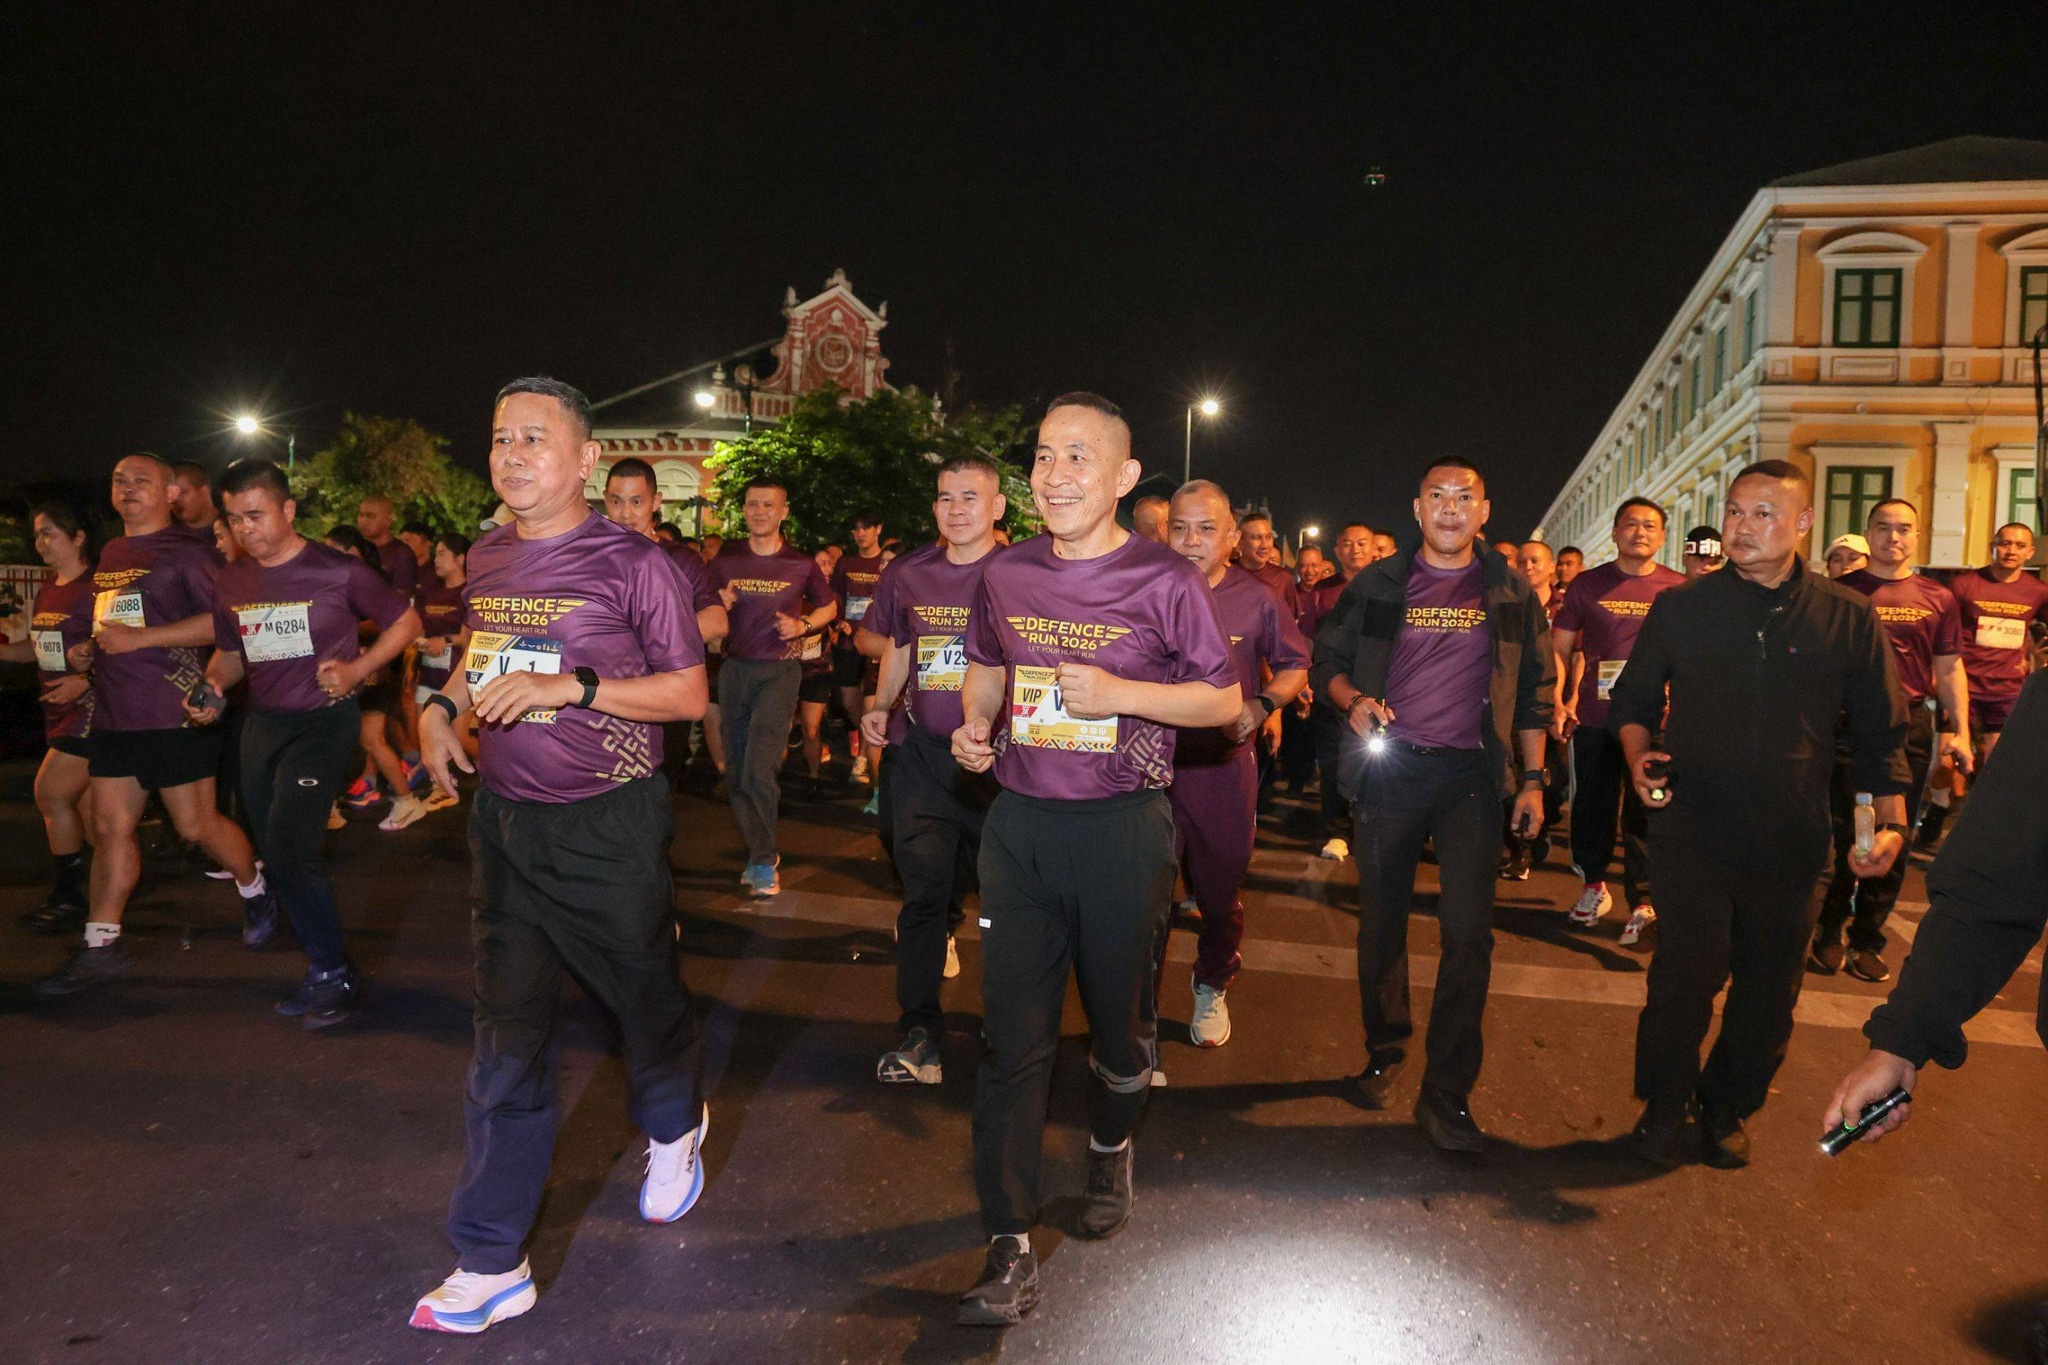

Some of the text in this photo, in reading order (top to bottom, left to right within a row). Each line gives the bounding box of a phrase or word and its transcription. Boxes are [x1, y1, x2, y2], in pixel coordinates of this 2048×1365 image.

[740, 579, 780, 589] DEFENCE
[115, 598, 140, 613] 6088
[482, 597, 557, 613] DEFENCE
[1611, 600, 1652, 610] DEFENC
[484, 611, 549, 626] RUN 2026
[1412, 607, 1477, 619] DEFENCE
[264, 618, 306, 636] M 6284
[929, 617, 968, 626] RUN 20
[1025, 616, 1106, 639] DEFENCE
[1414, 618, 1472, 628] RUN 2026
[246, 624, 257, 635] 3K
[495, 625, 512, 633] YOUR
[513, 626, 533, 634] HEART
[534, 627, 548, 635] RUN
[43, 641, 62, 654] 6078
[1028, 632, 1098, 651] RUN 2026
[922, 650, 935, 662] VIP
[1041, 646, 1060, 655] YOUR
[1061, 648, 1080, 657] HEART
[1081, 651, 1096, 660] RUN
[472, 653, 489, 669] VIP
[500, 655, 511, 675] V
[1023, 688, 1042, 703] VIP
[1053, 689, 1064, 711] V
